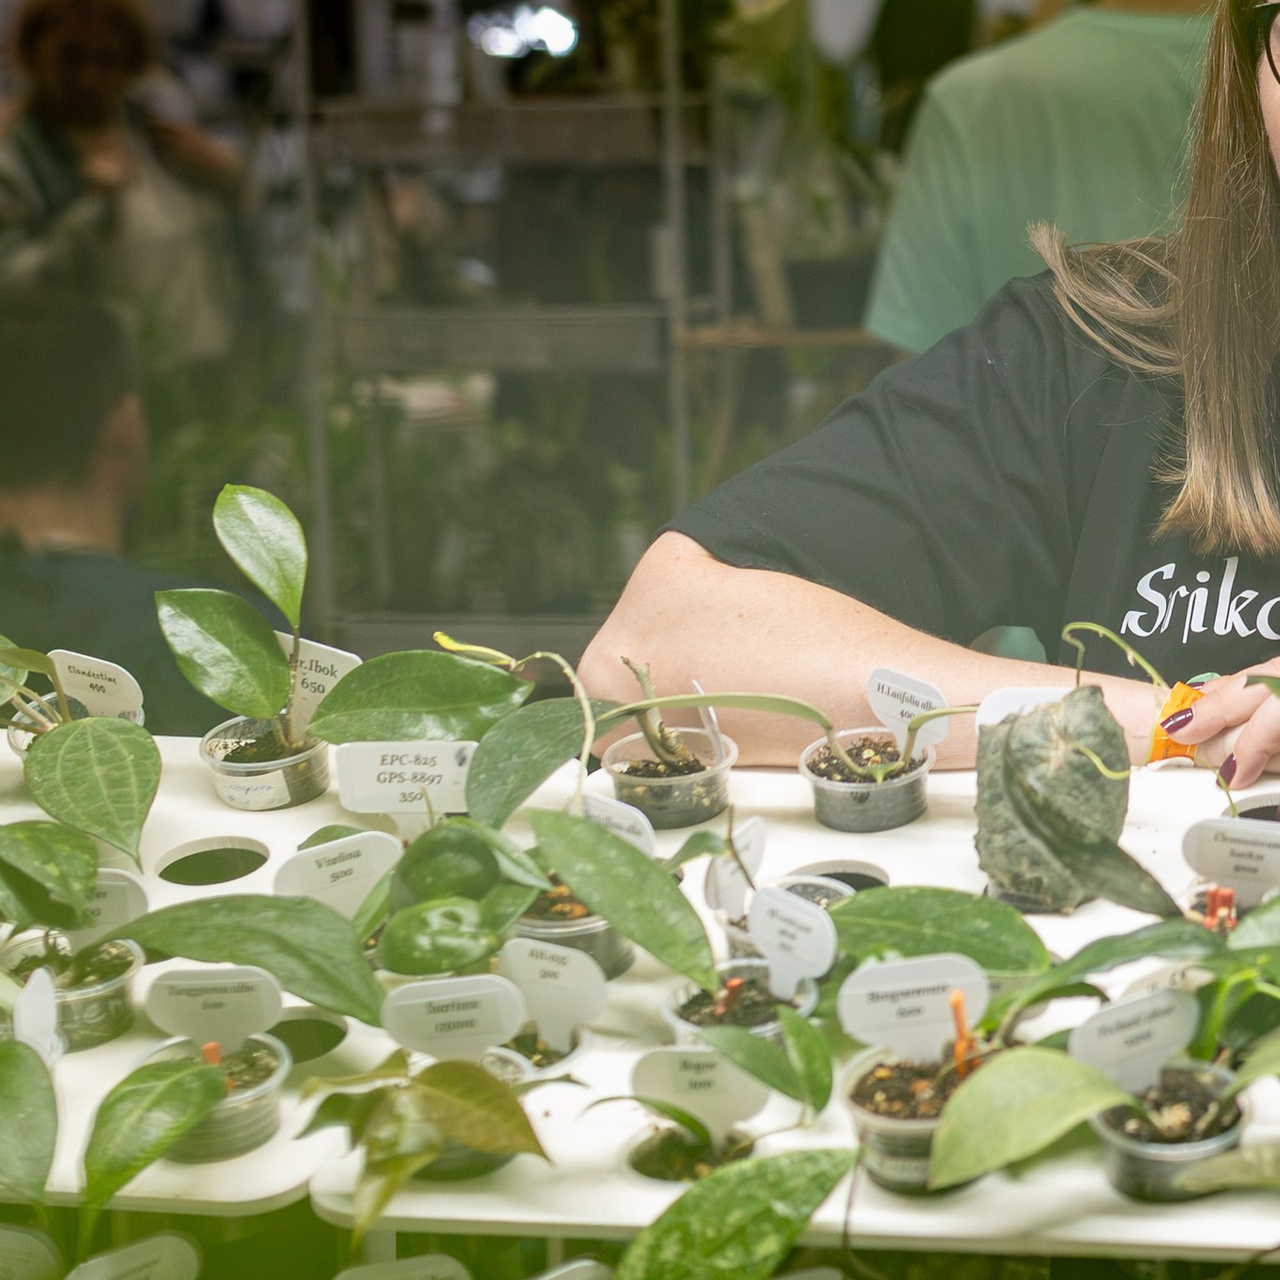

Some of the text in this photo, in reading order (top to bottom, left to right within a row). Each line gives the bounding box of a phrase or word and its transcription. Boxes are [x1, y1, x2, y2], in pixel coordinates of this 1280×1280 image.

[301, 677, 325, 694] 650
[380, 753, 437, 768] EPC-825
[376, 771, 443, 786] GPS-8897
[399, 791, 424, 803] 350
